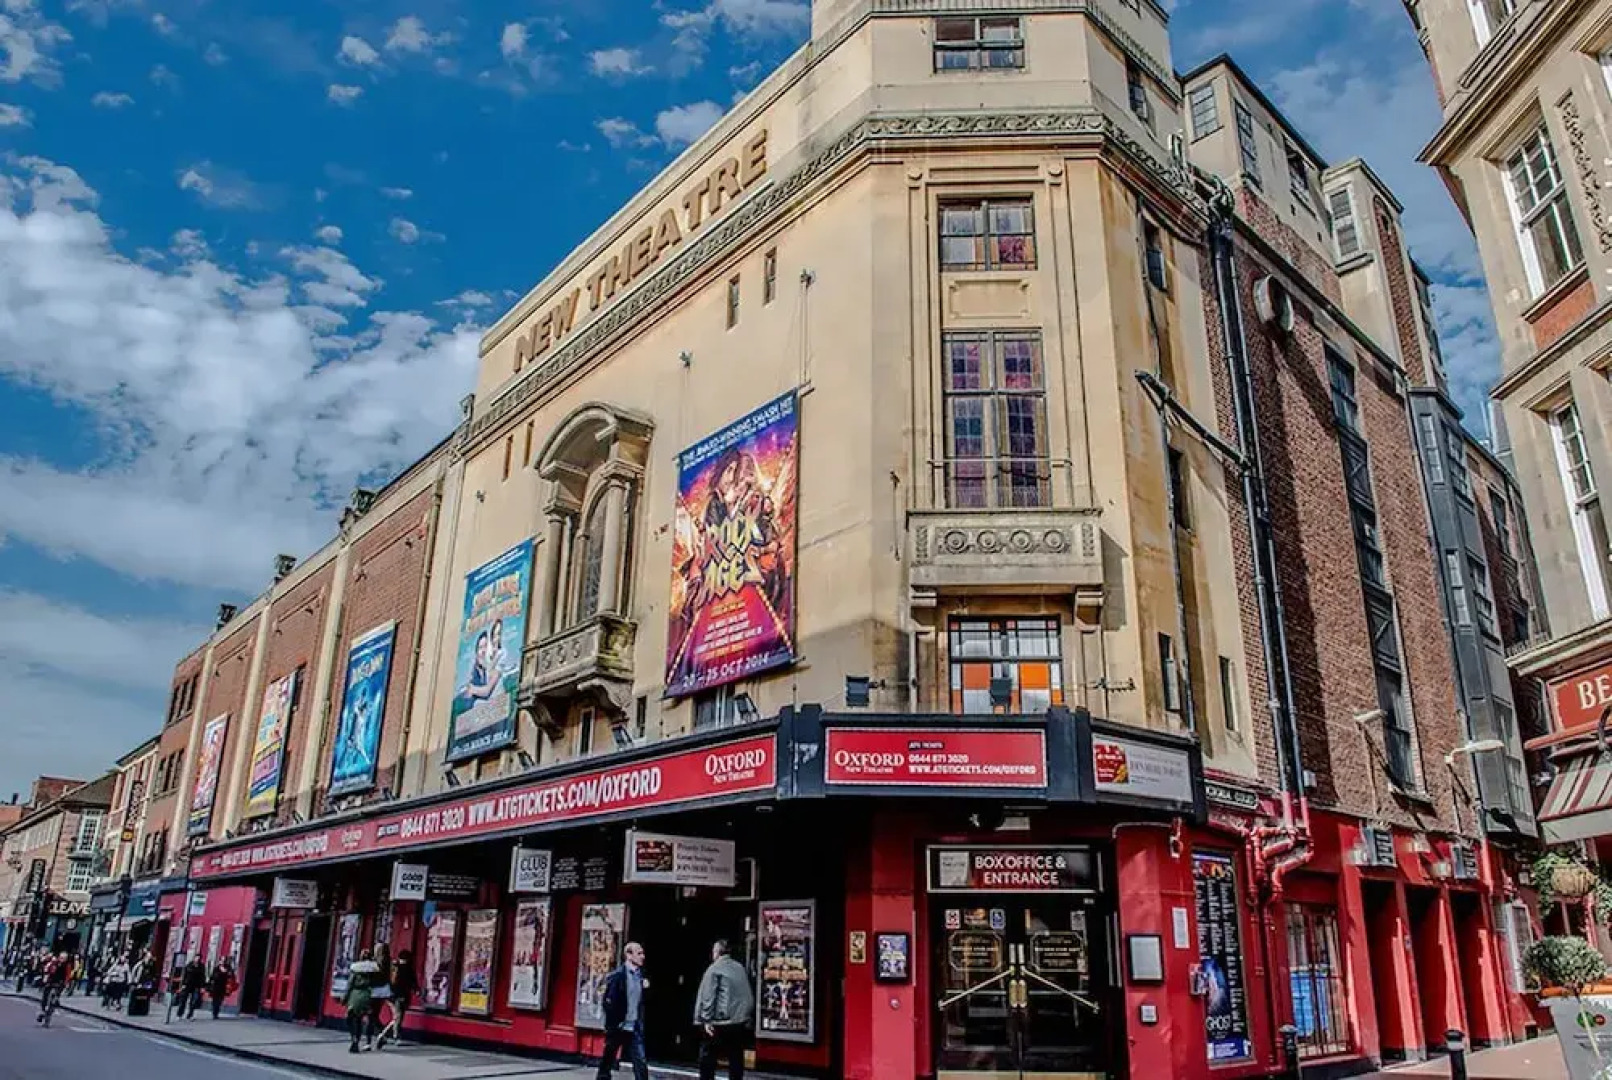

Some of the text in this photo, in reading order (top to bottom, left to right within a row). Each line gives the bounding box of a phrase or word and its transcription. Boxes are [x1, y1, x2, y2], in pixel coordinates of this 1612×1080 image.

[512, 128, 768, 374] NEW THEATRE
[704, 511, 766, 558] ROCK
[719, 657, 744, 677] OCT
[704, 748, 767, 776] OXFORD
[834, 749, 905, 767] OXFORD
[844, 765, 862, 774] NEW
[441, 806, 466, 831] 3020
[467, 766, 662, 827] WWW.ATGTICKETS.COM/OXFORD
[520, 855, 548, 871] CLUB
[974, 855, 1067, 870] BOX OFFICE &
[402, 872, 424, 882] GOOD
[983, 871, 1060, 886] ENTRANCE
